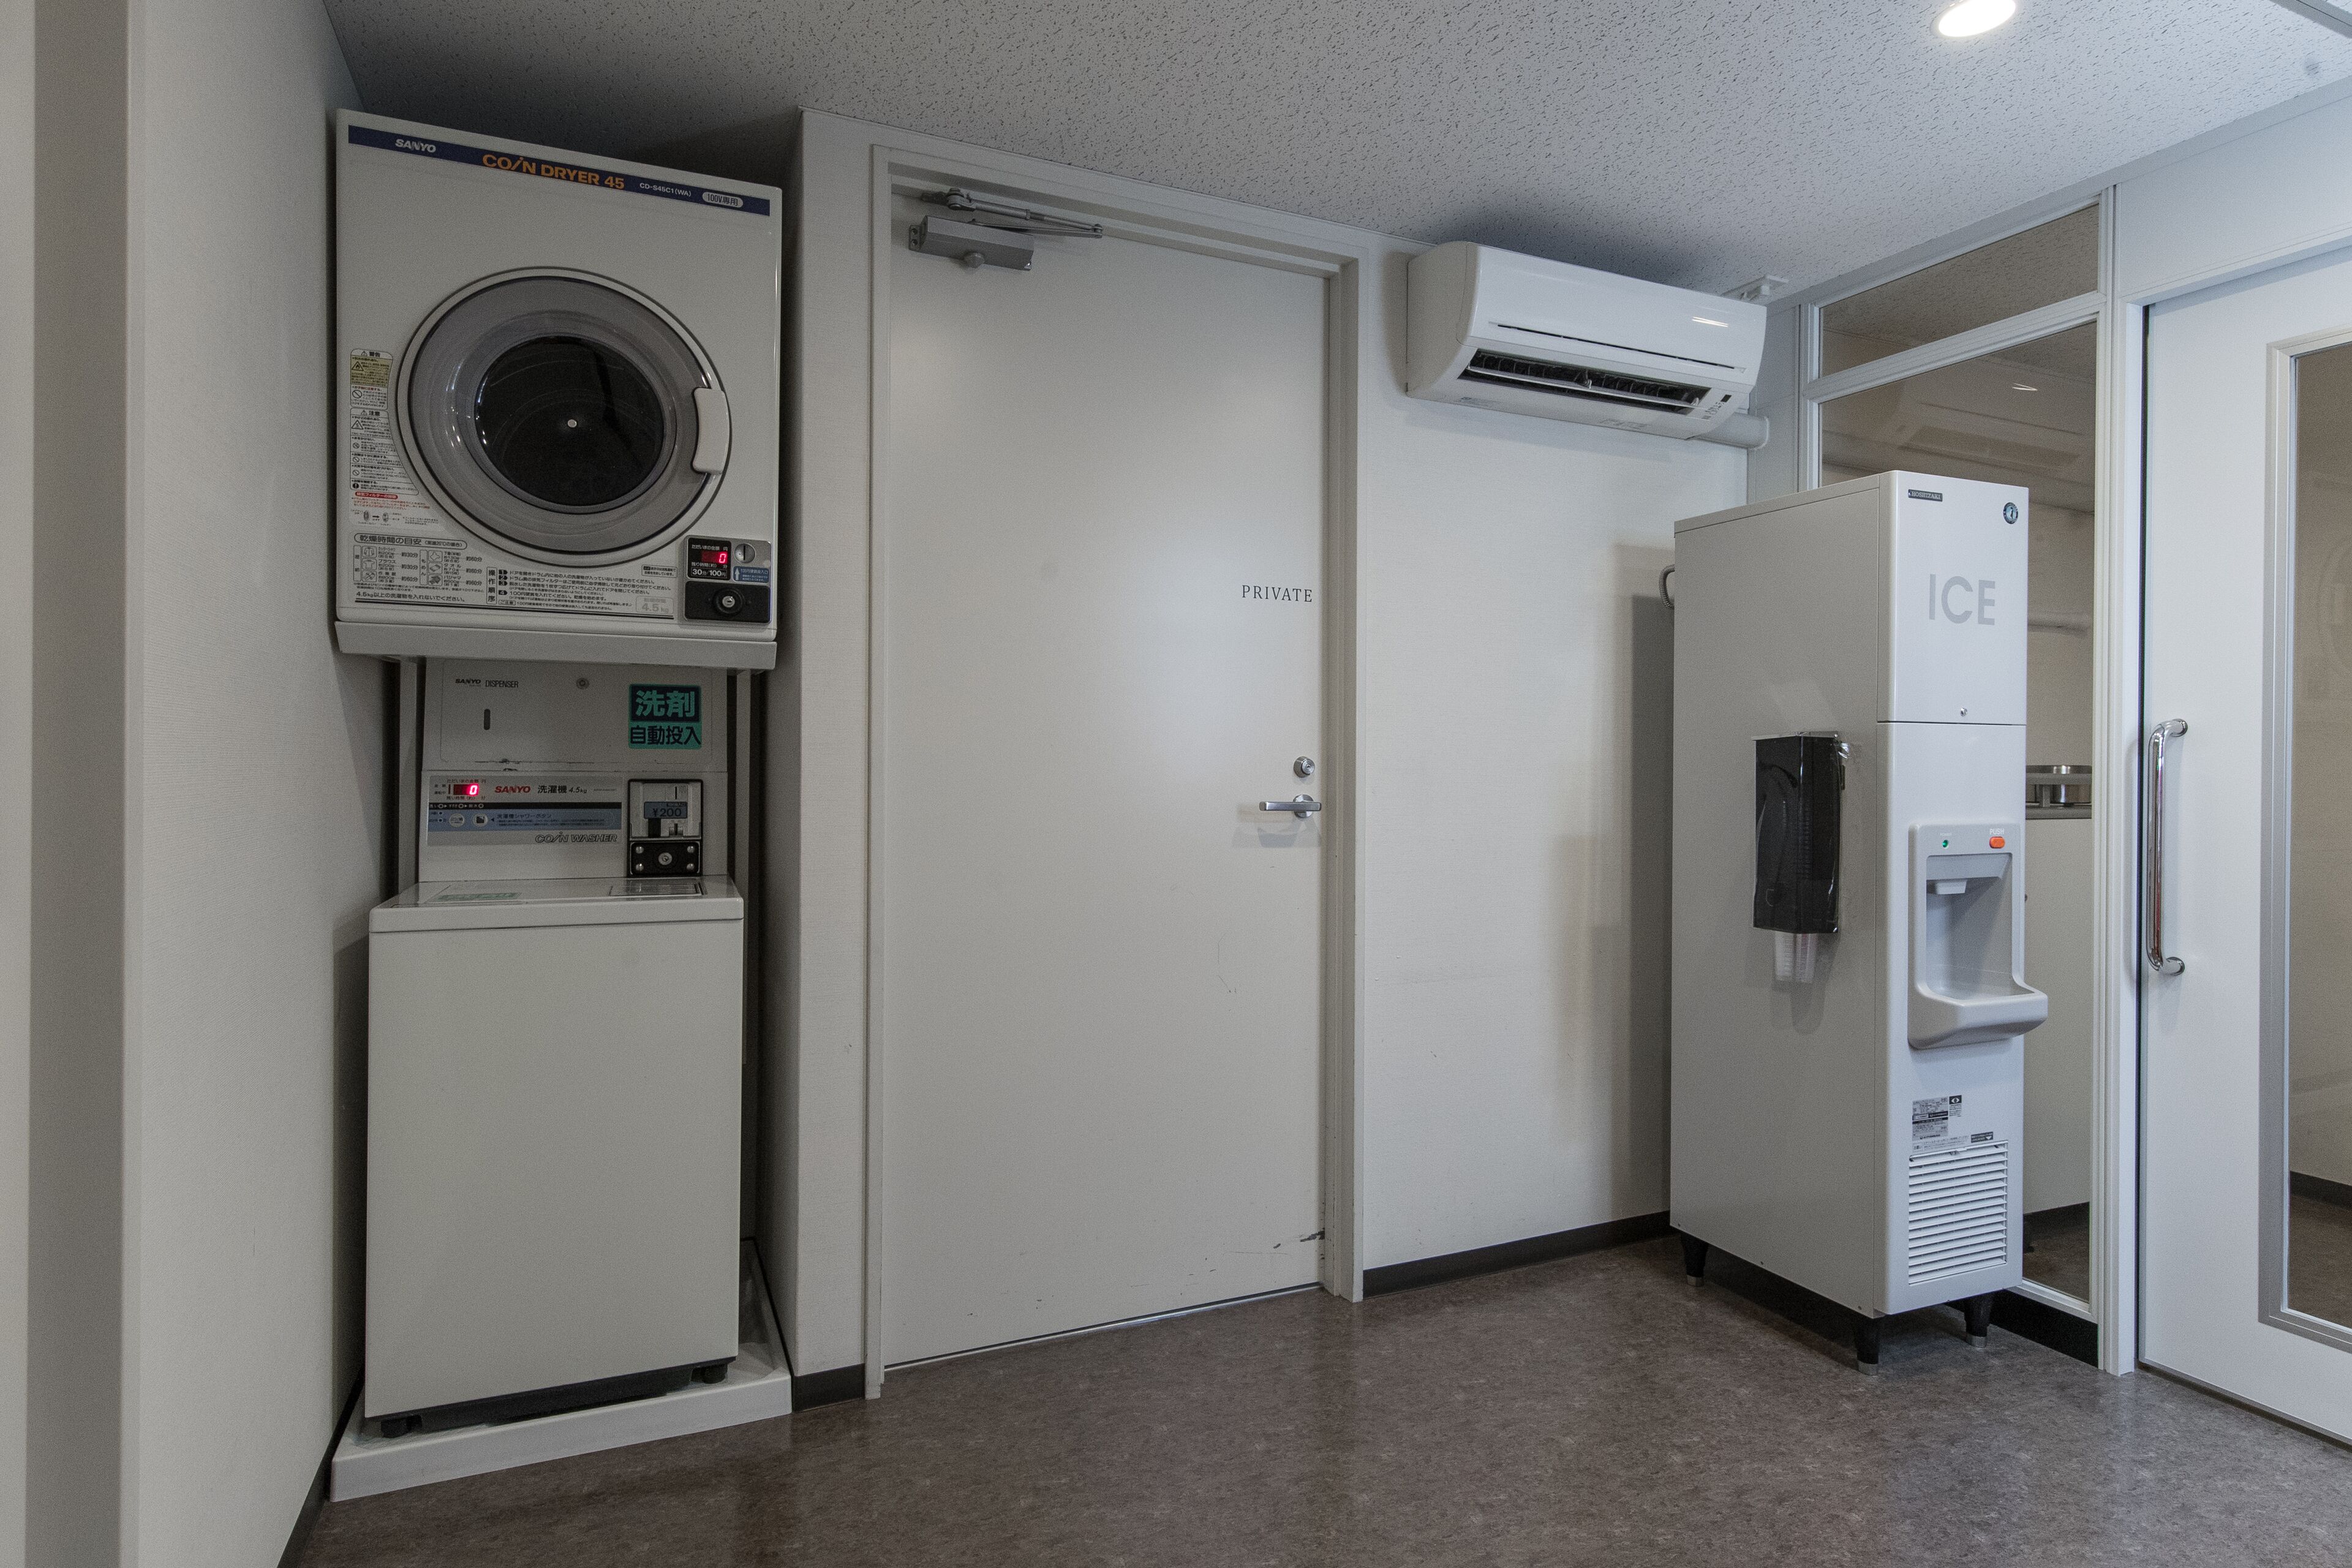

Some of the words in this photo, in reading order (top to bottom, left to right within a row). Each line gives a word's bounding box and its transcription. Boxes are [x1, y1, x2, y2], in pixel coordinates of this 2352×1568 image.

[395, 138, 436, 153] SANYO
[541, 164, 600, 185] DRYER
[604, 175, 625, 190] 45
[707, 193, 738, 206] 100V専用
[1912, 491, 1941, 500] HOSHIZAKI
[359, 535, 421, 545] 乾燥時間の目安
[719, 553, 726, 564] 0
[1242, 585, 1312, 602] PRIVATE
[1929, 574, 1996, 625] ICE
[485, 680, 519, 688] DISPENSER
[636, 690, 695, 717] 洗剤
[630, 725, 701, 745] 自動投入
[470, 785, 478, 796] 0
[537, 785, 567, 794] 洗濯機
[652, 808, 682, 817] ¥200
[571, 834, 617, 843] WASHER
